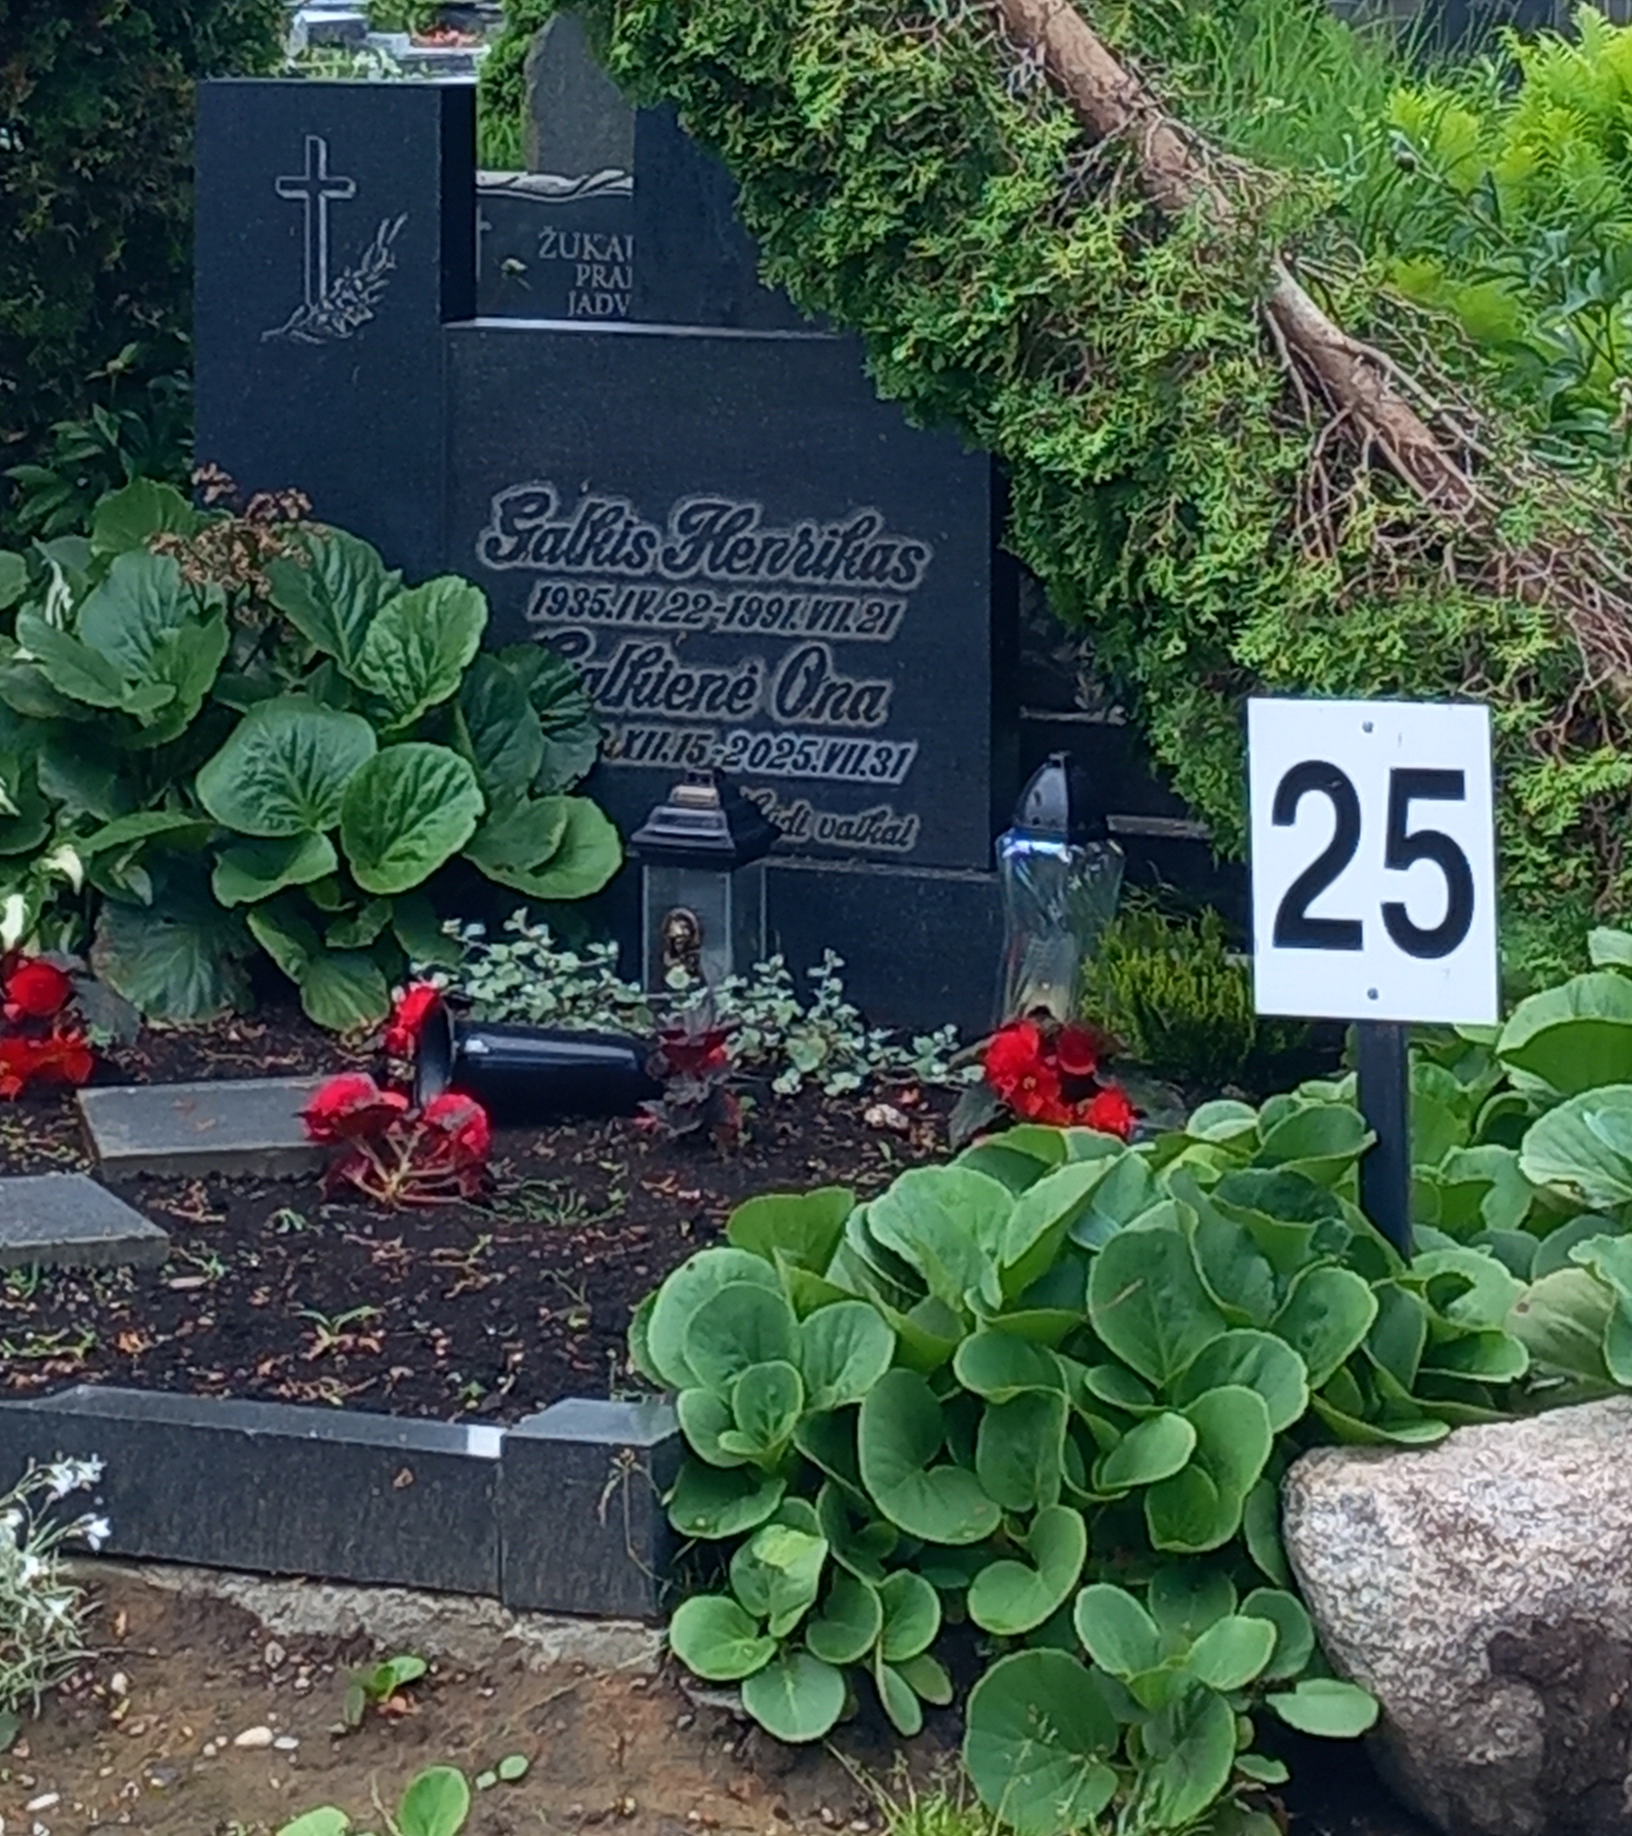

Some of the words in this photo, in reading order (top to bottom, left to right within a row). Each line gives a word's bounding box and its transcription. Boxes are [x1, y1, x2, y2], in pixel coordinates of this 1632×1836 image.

[481, 485, 659, 568] Galkis
[660, 497, 931, 589] Henrikas
[773, 644, 889, 724] Ona
[1271, 759, 1475, 960] 25
